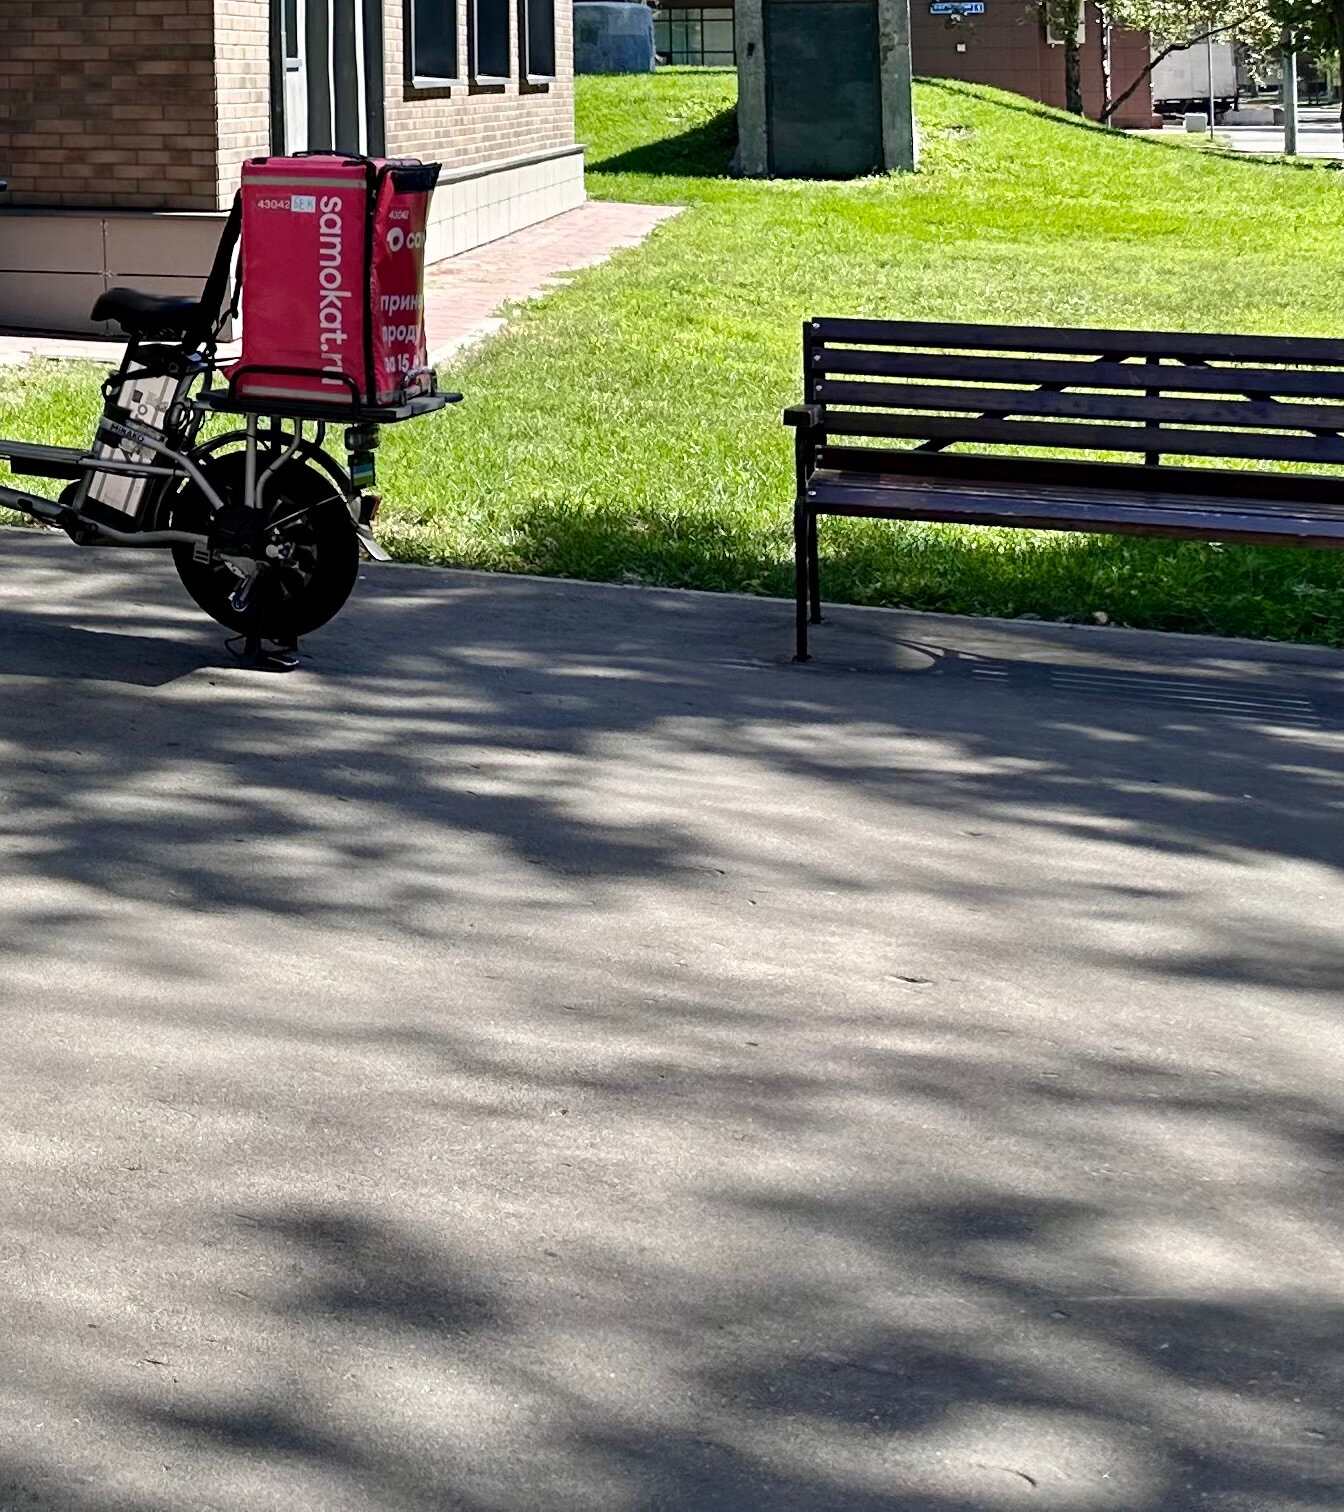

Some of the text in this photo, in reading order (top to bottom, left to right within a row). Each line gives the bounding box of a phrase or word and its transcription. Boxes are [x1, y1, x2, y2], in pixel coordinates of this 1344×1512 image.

[257, 199, 290, 210] 43042
[319, 195, 351, 385] samokat.ru
[398, 353, 410, 373] 15
